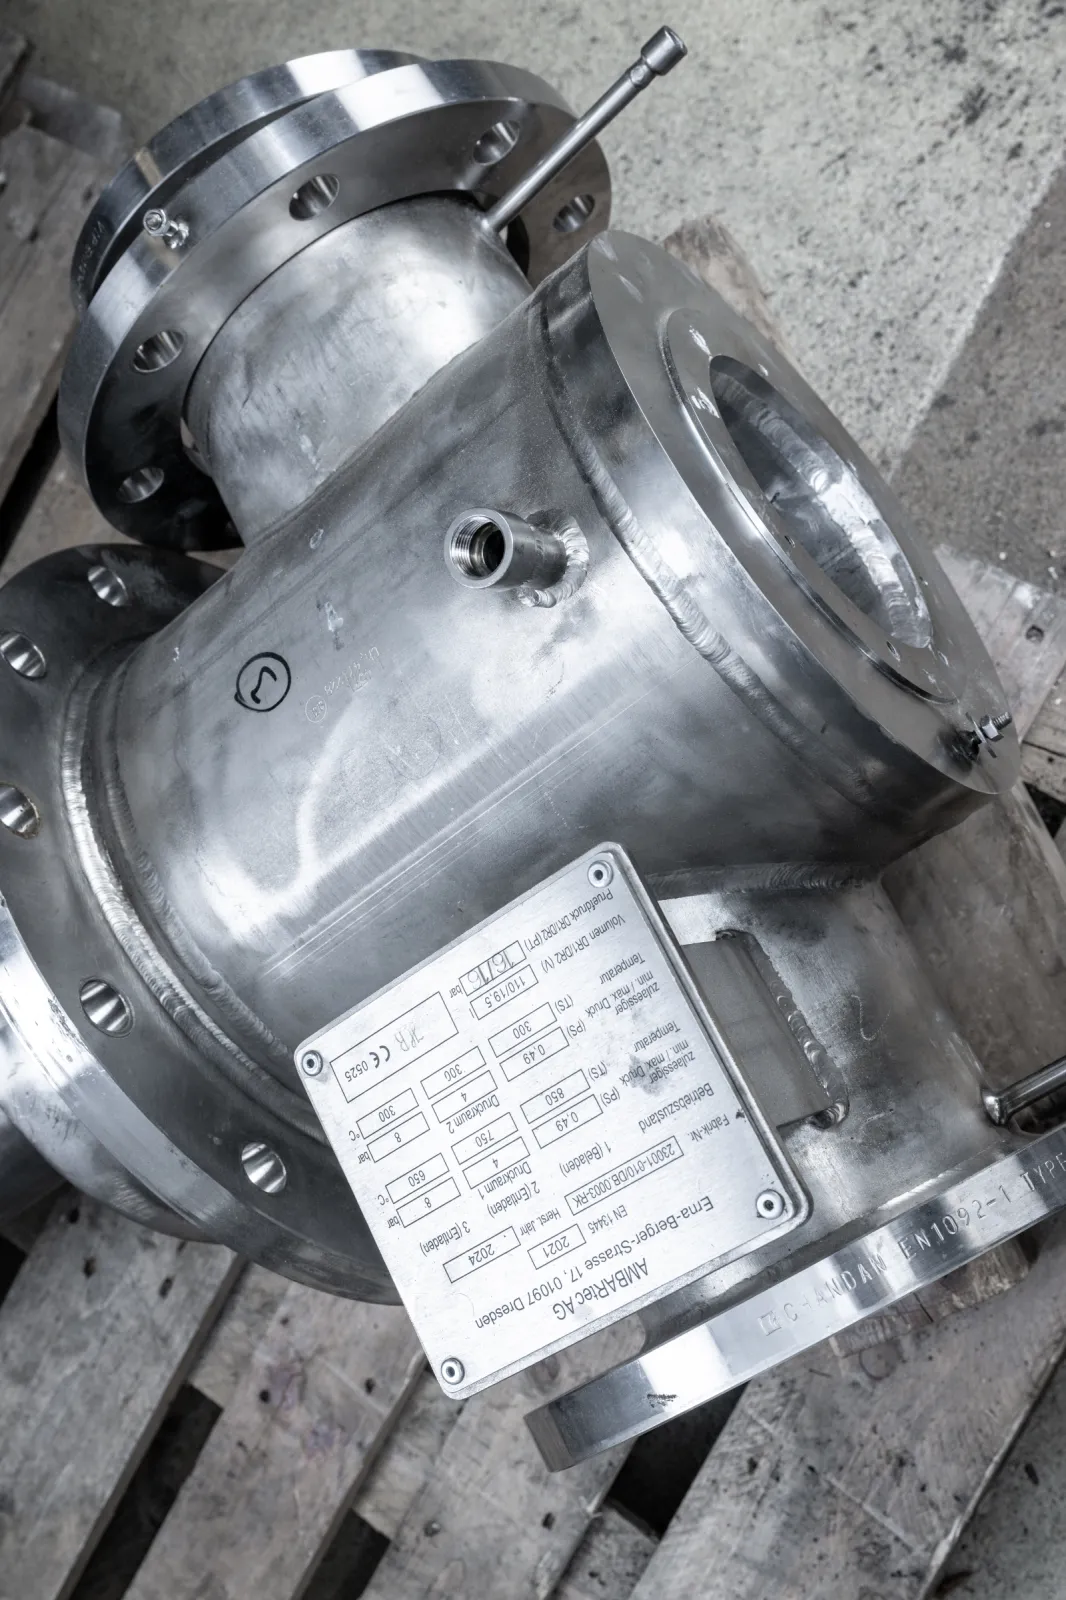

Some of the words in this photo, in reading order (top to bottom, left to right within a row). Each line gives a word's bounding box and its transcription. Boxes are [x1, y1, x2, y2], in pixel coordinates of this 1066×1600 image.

[569, 885, 614, 922] Pruefdruck
[540, 915, 572, 941] DR1/DR2
[589, 914, 626, 940] Volumen
[524, 932, 543, 952] (PT)
[554, 935, 590, 964] DR1/DR2
[467, 948, 515, 991] 16/16
[541, 956, 555, 974] (V)
[599, 952, 645, 985] Temperatur
[635, 970, 654, 986] min.
[449, 984, 463, 998] bar
[609, 984, 631, 1002] max.
[610, 982, 660, 1016] zulaessiger
[554, 994, 574, 1014] (TS)
[584, 997, 611, 1018] Druck
[512, 1020, 532, 1039] 300
[566, 1018, 586, 1039] (PS)
[633, 1021, 681, 1052] Temperatur
[669, 1039, 689, 1054] min.
[344, 1060, 369, 1082] 0525
[444, 1064, 463, 1082] 300
[588, 1060, 608, 1082] (TS)
[644, 1053, 665, 1072] max.
[645, 1051, 696, 1085] zulaessiger
[619, 1065, 647, 1086] Druck
[461, 1092, 467, 1102] 4
[545, 1087, 565, 1106] 850
[600, 1086, 620, 1107] (PS)
[378, 1105, 396, 1123] 300
[453, 1094, 500, 1127] Druckraum
[638, 1082, 715, 1134] Betriebszustand
[394, 1132, 402, 1143] 8
[446, 1121, 455, 1134] 2
[687, 1114, 730, 1142] Fabrik-Nr.
[475, 1130, 495, 1147] 750
[604, 1141, 611, 1153] 1
[357, 1151, 373, 1164] bar
[492, 1158, 498, 1169] 4
[559, 1142, 604, 1178] (Beladen)
[408, 1170, 426, 1187] 650
[483, 1161, 532, 1194] Druckraum
[572, 1143, 675, 1208] 23001-010/DB.0003-RK
[477, 1188, 485, 1200] 1
[530, 1181, 540, 1194] 2
[424, 1197, 432, 1208] 8
[487, 1183, 532, 1219] (Entladen)
[387, 1215, 401, 1229] bar
[536, 1208, 561, 1226] Herst.
[612, 1204, 628, 1220] EN
[897, 1184, 1013, 1260] EN1092-1
[462, 1221, 471, 1234] 3
[520, 1220, 536, 1236] Jahr
[584, 1196, 714, 1270] Erna-Berger-Strasse
[587, 1213, 613, 1234] 13445
[419, 1222, 463, 1257] (Entladen)
[542, 1236, 570, 1258] 2021
[468, 1243, 495, 1266] 2024
[563, 1266, 583, 1283] 17,
[575, 1257, 648, 1305] AMBARtec
[527, 1276, 563, 1306] 01097
[475, 1297, 525, 1329] Dresden
[552, 1296, 575, 1320] AG
